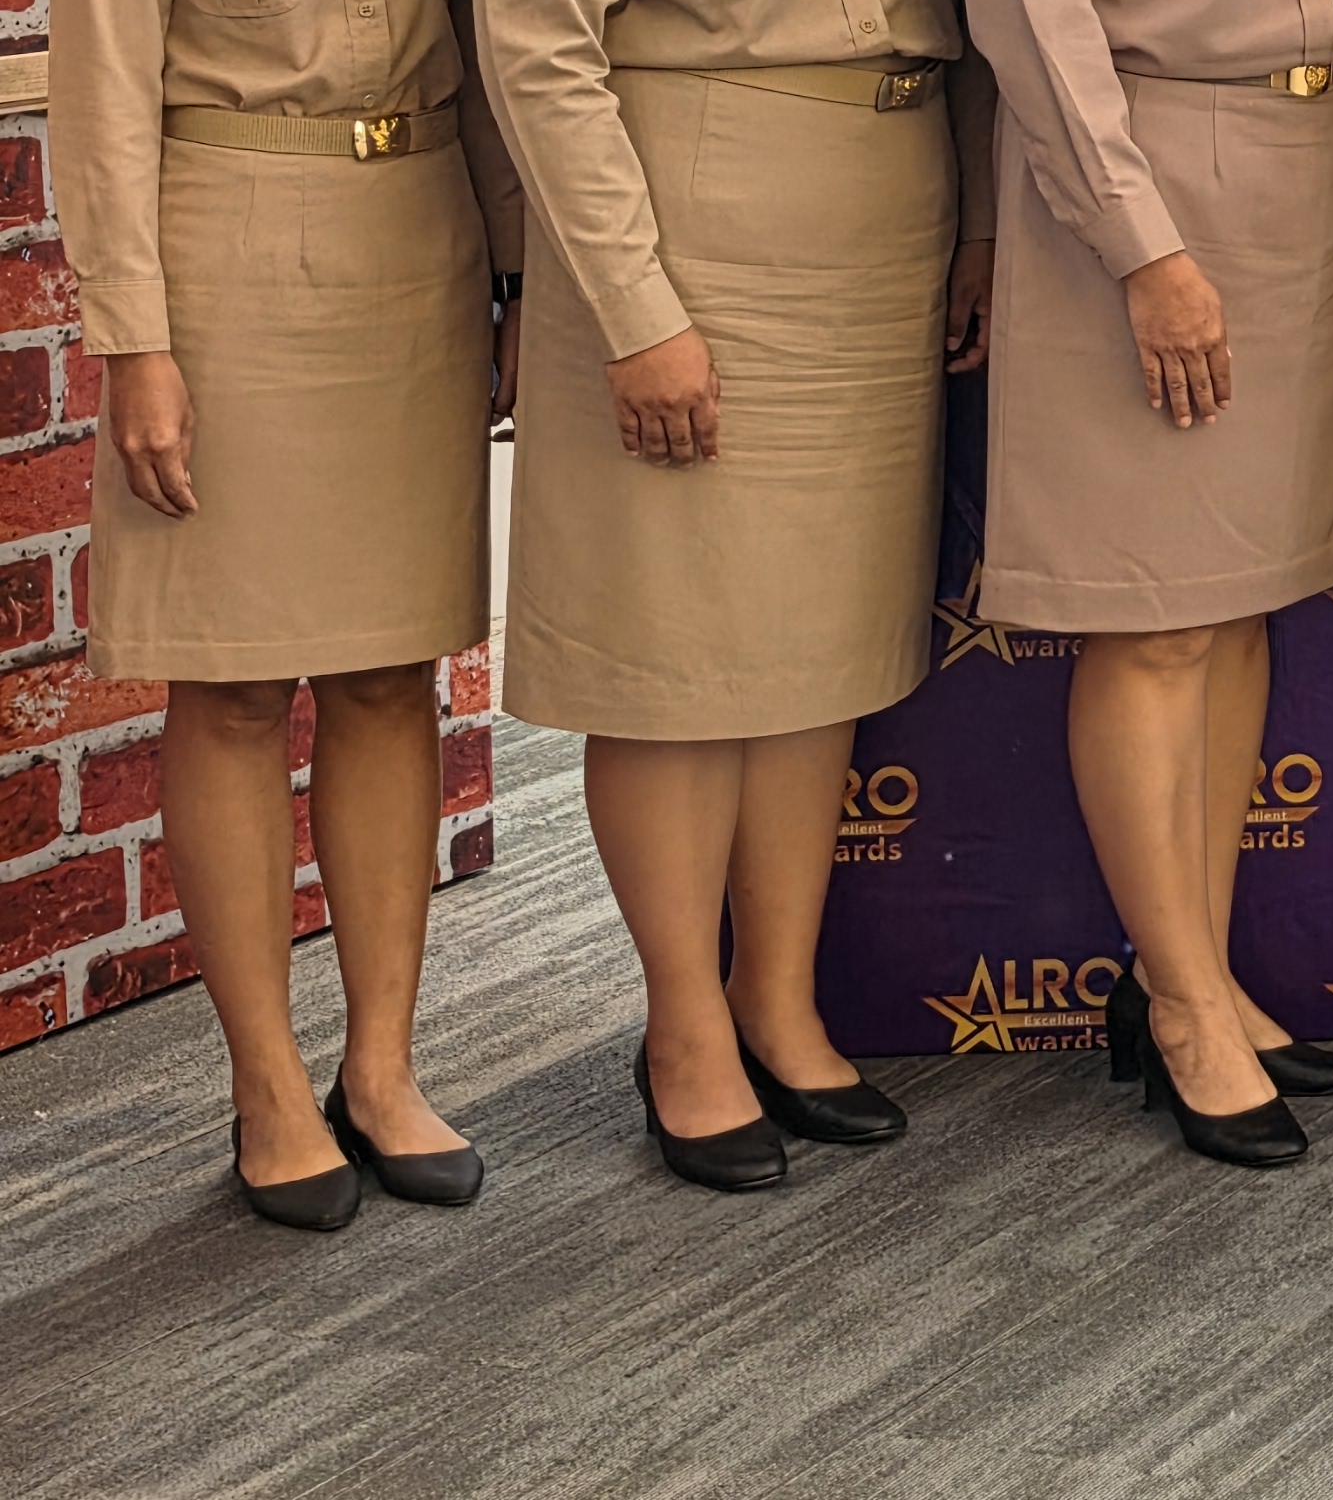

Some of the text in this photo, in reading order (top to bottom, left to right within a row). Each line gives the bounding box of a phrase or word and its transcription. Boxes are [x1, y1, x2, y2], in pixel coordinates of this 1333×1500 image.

[834, 836, 902, 862] ards
[1240, 824, 1305, 849] ards
[1024, 1013, 1090, 1026] Excellent
